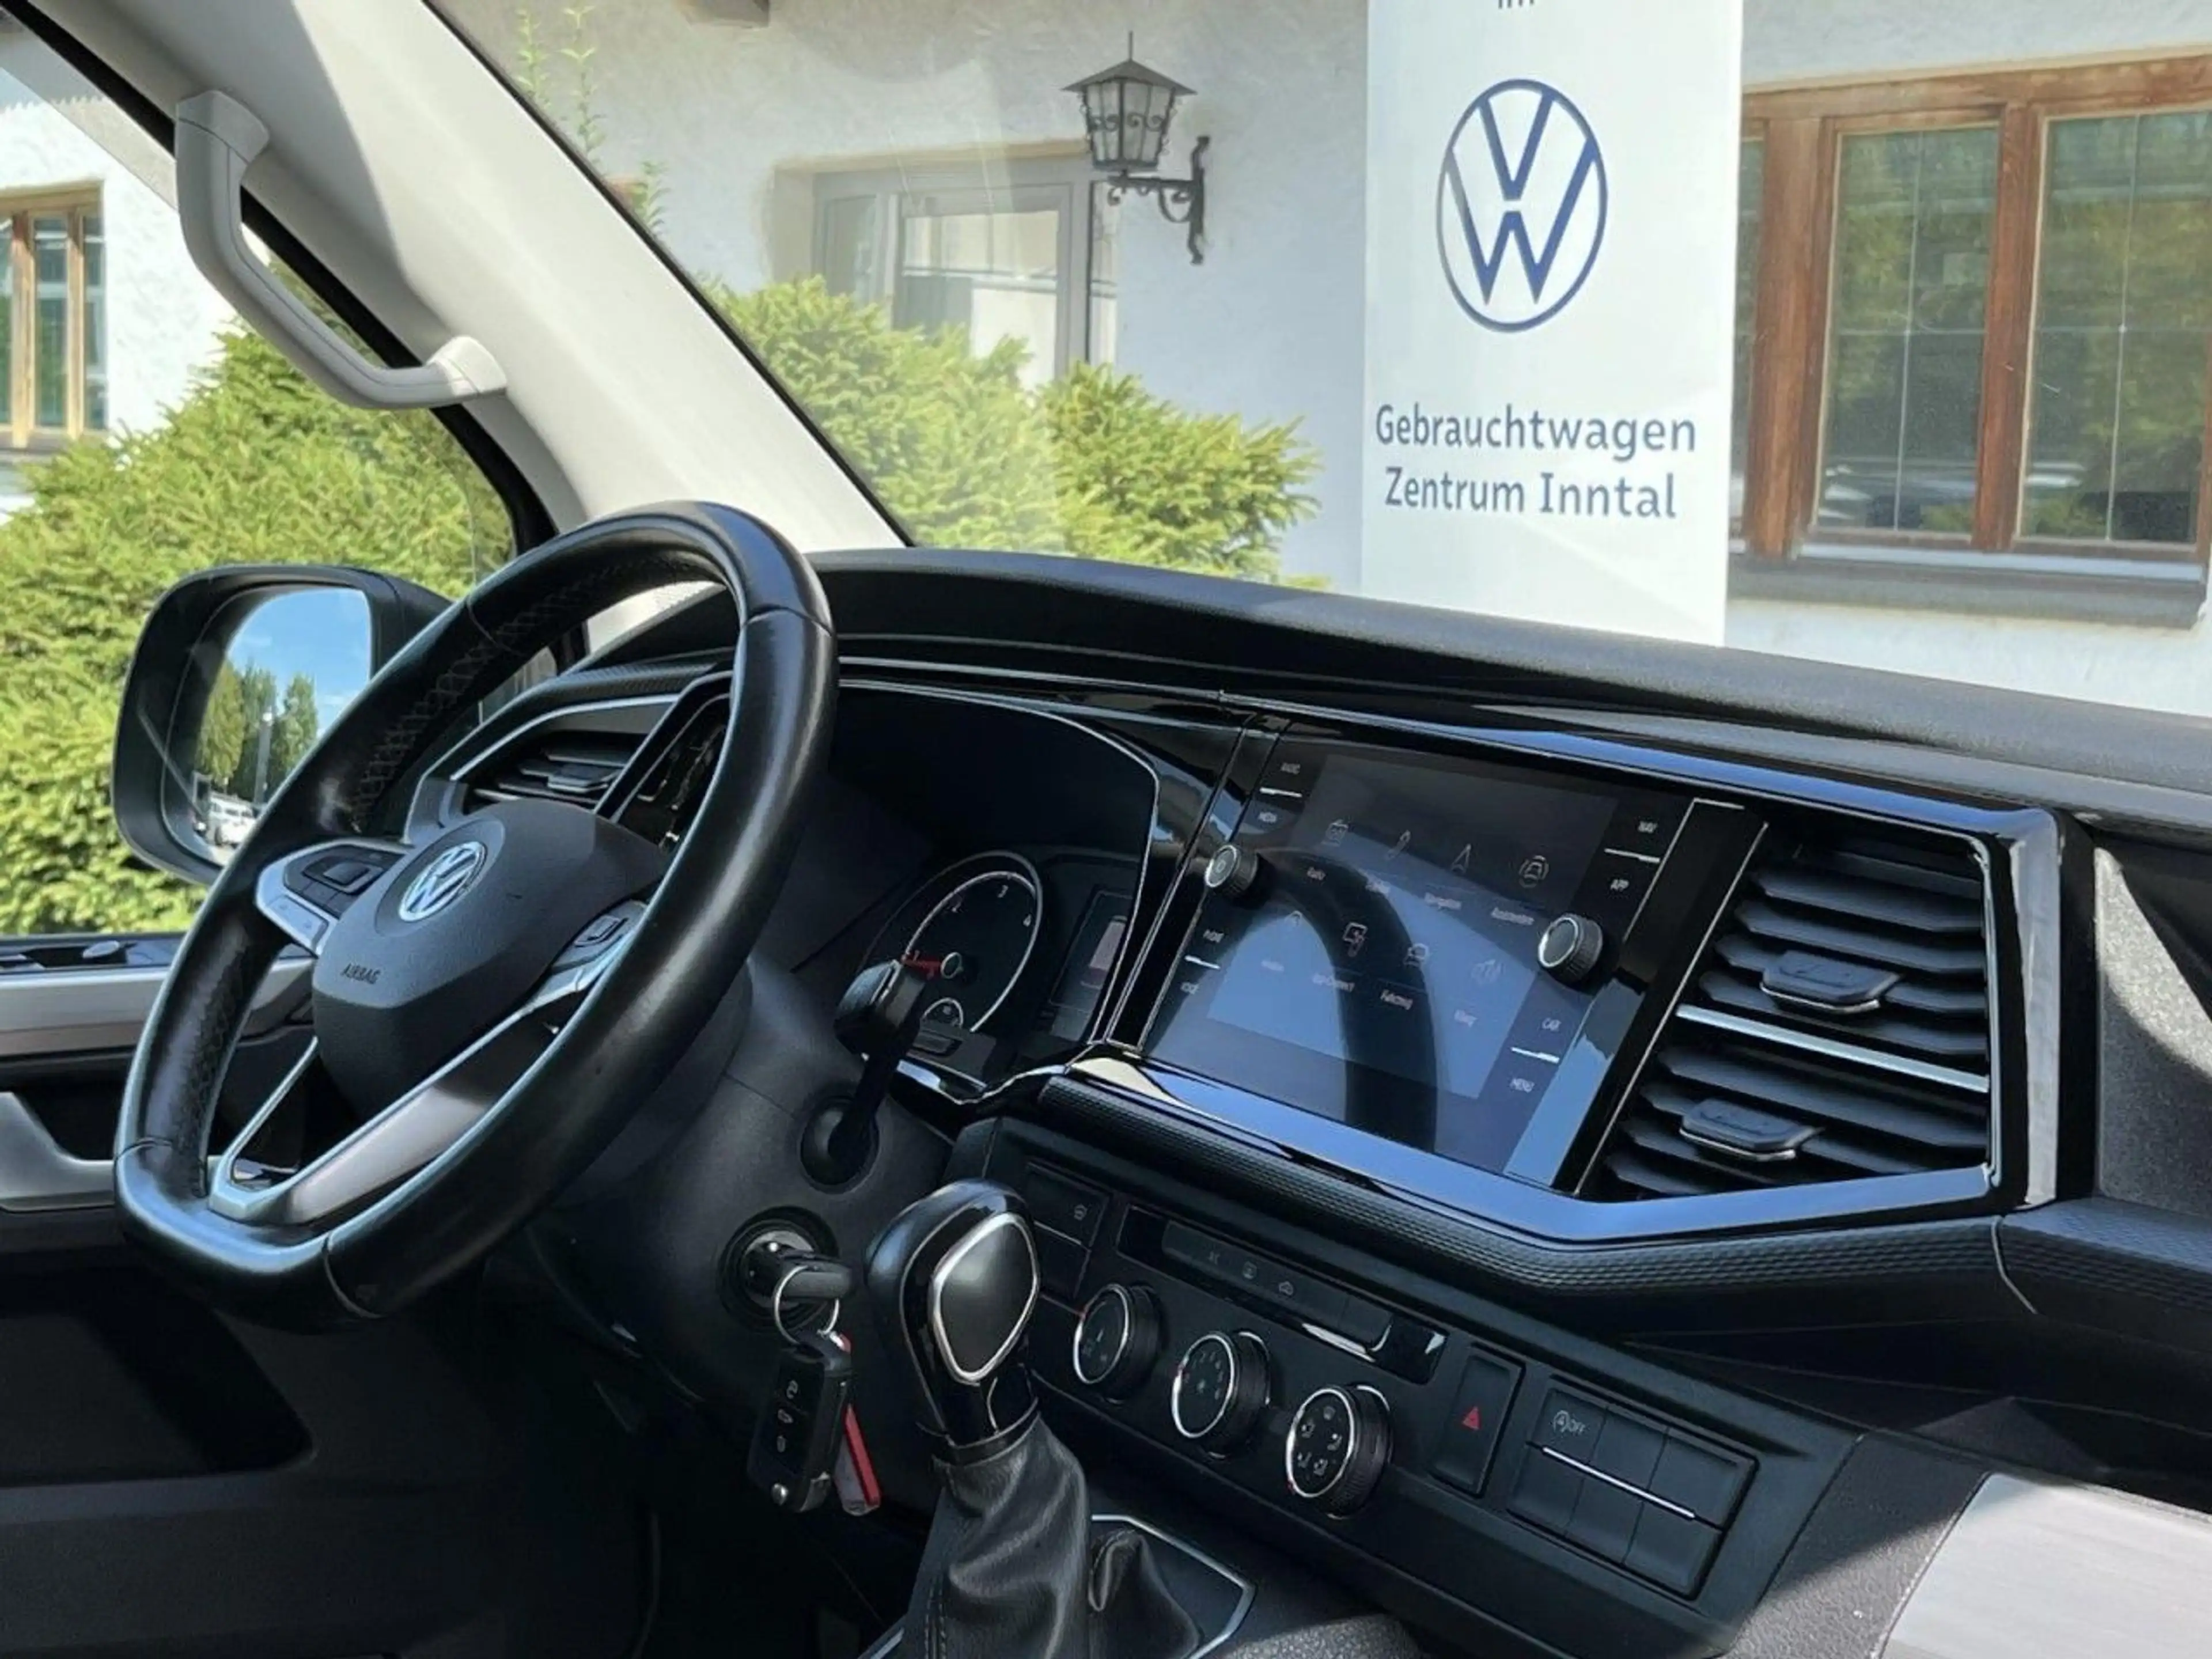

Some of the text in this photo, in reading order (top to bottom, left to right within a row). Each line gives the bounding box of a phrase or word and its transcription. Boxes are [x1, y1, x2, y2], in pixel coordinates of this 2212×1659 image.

[1440, 81, 1604, 320] VW
[1375, 402, 1696, 463] Gebrauchtwagen
[1384, 466, 1677, 518] Zentrum Inntal
[340, 963, 381, 984] AIRBAG
